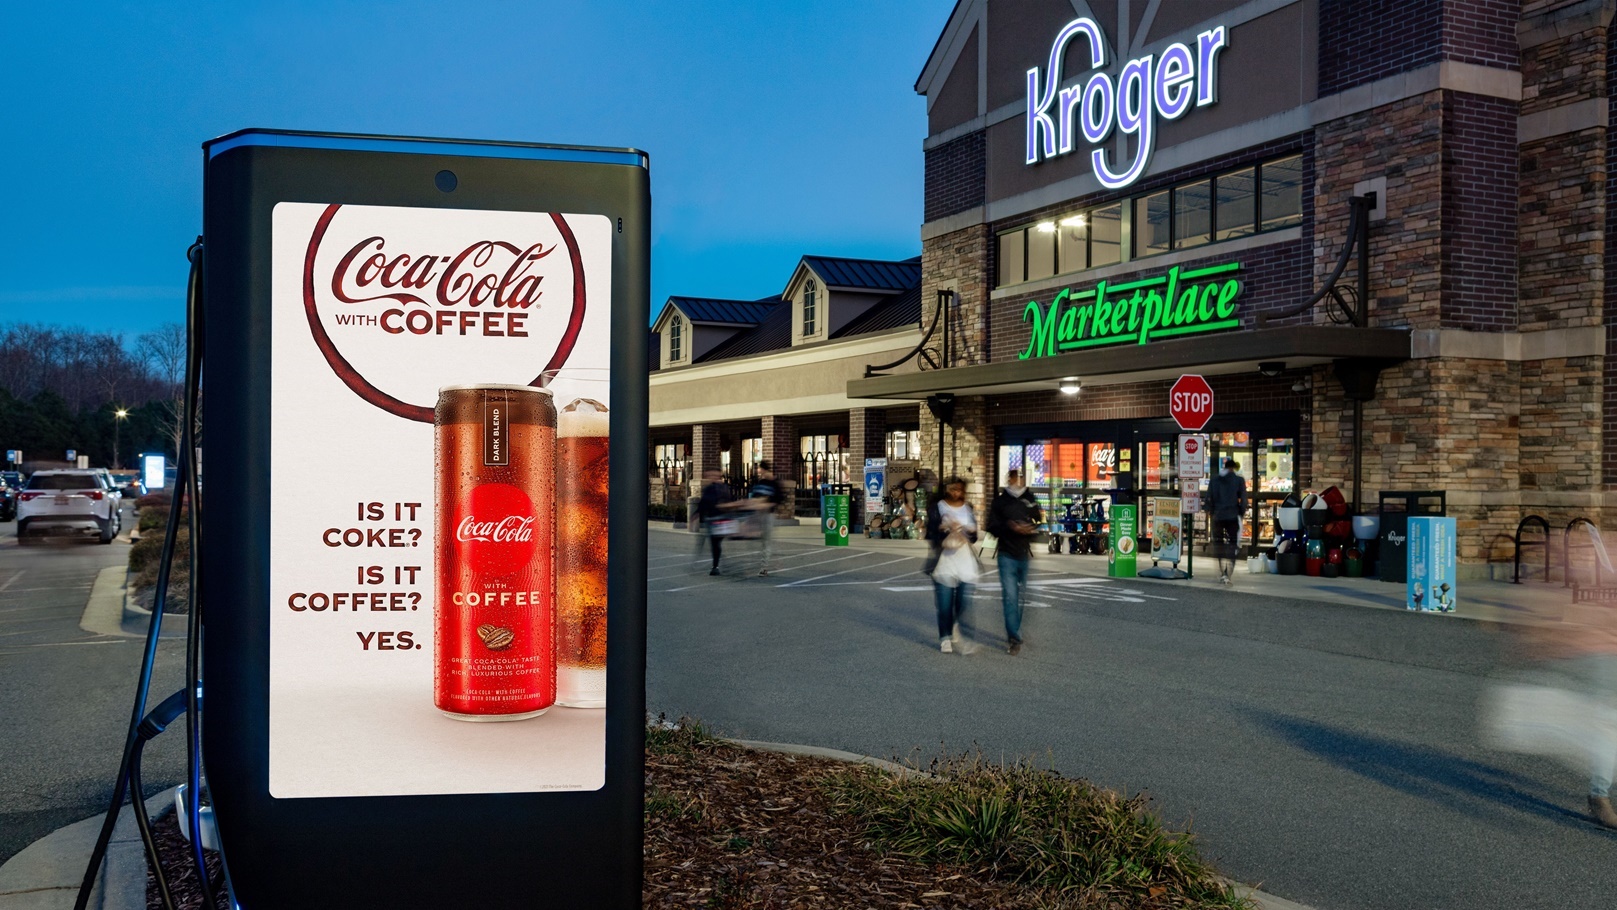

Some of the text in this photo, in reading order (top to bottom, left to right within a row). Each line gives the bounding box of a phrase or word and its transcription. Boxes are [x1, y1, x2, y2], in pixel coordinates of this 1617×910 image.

[1026, 17, 1226, 189] Kroger
[331, 235, 558, 309] Coca-Cola
[335, 308, 529, 337] WITH COFFEE
[1018, 266, 1239, 360] Marketplace
[1173, 392, 1210, 413] STOP
[358, 502, 422, 521] IS IT
[456, 515, 536, 542] Coca-Cola
[1388, 530, 1406, 547] Kroger
[358, 566, 422, 585] IS IT
[288, 592, 422, 612] COFFEE?
[452, 591, 540, 606] COFFEE
[356, 631, 422, 650] YES.
[522, 655, 541, 663] TASTE
